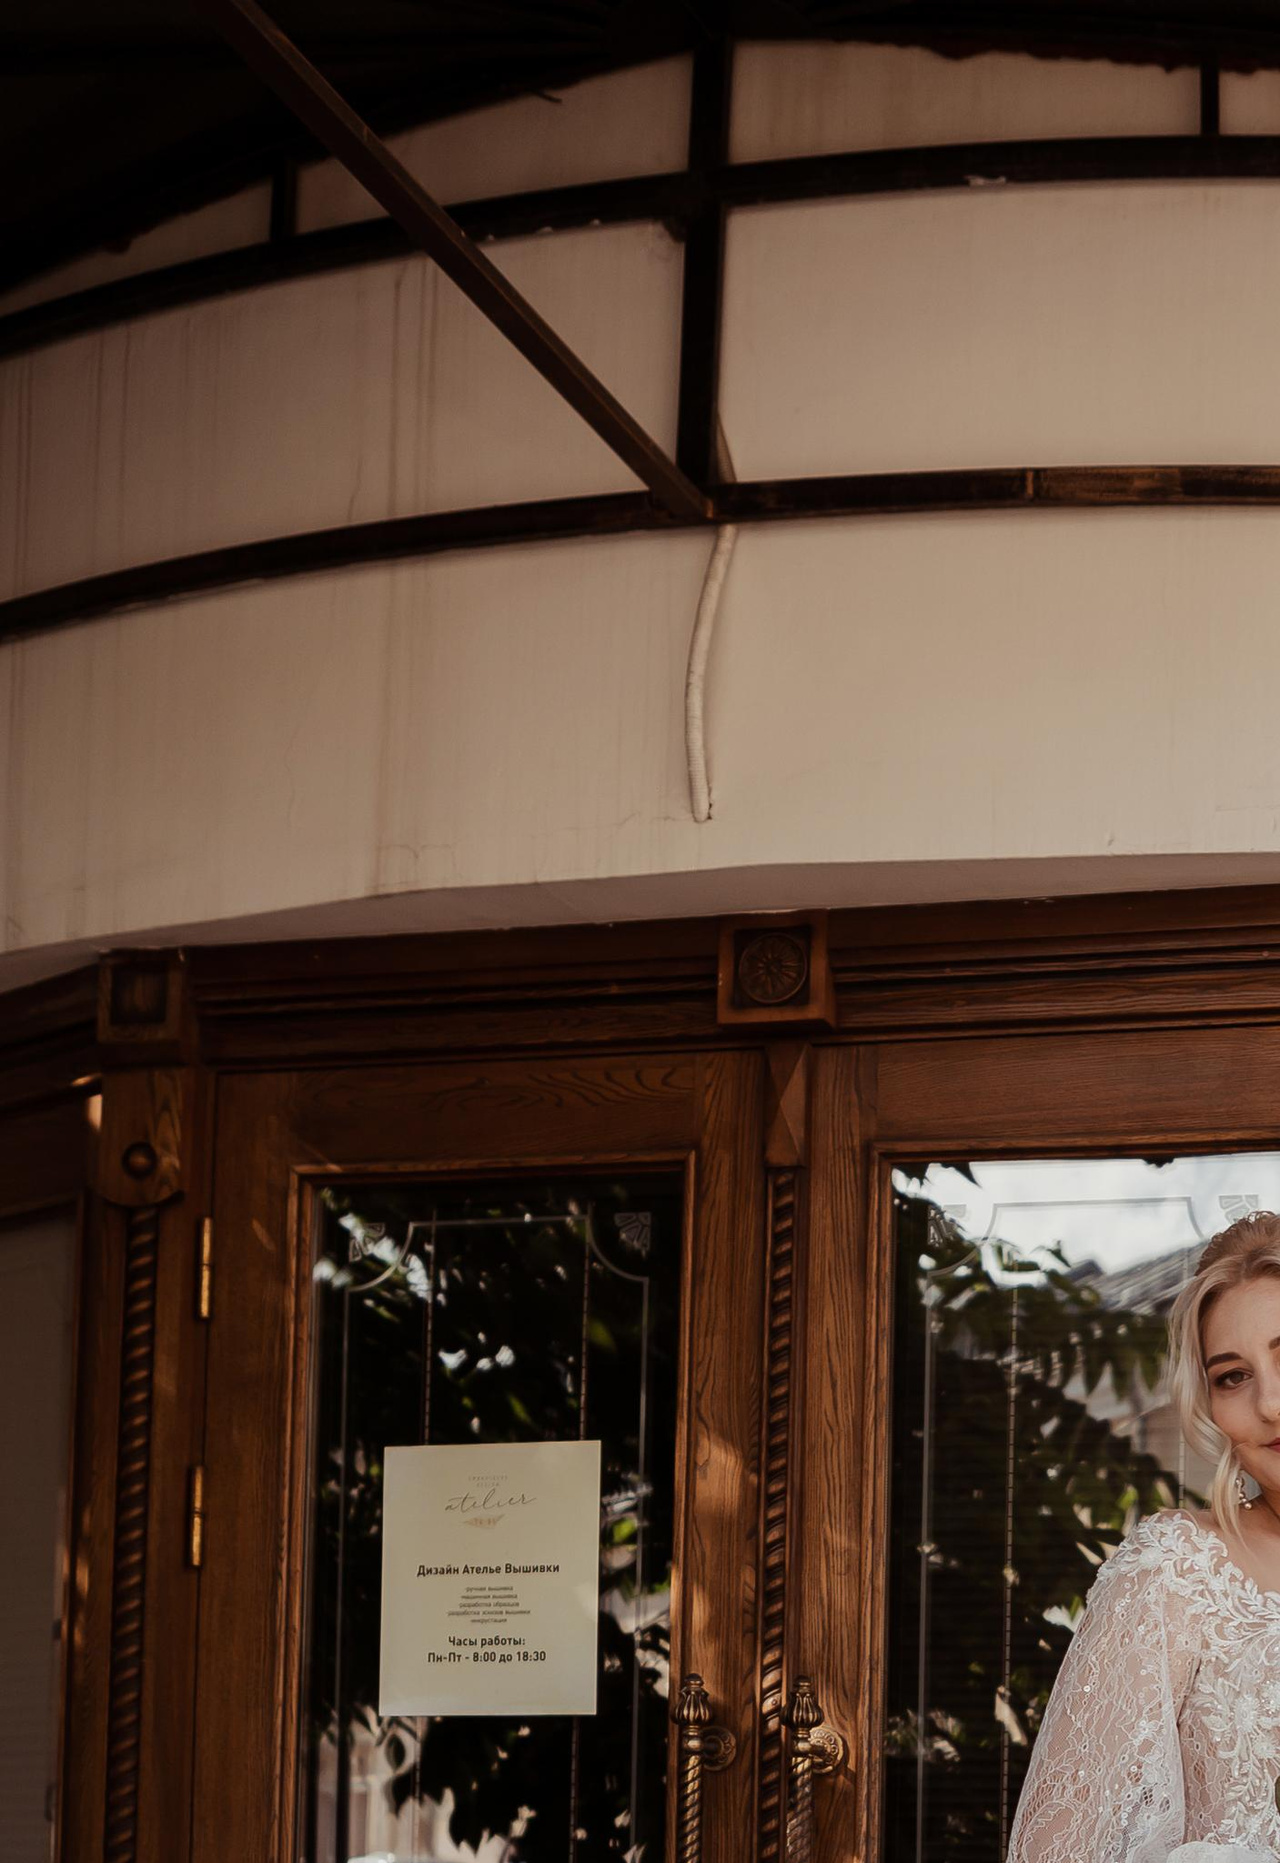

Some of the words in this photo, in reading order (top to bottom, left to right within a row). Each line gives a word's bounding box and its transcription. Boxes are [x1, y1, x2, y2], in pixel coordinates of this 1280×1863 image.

[445, 1487, 537, 1513] atelier
[417, 1564, 459, 1577] Дизайн
[462, 1564, 501, 1575] Ателье
[504, 1562, 560, 1574] Вышивки
[448, 1636, 478, 1646] Часы
[480, 1635, 526, 1648] работы:
[427, 1652, 462, 1662] Пн-Пт
[472, 1652, 496, 1662] 8:00
[498, 1653, 513, 1663] до
[516, 1650, 546, 1661] 18:30
